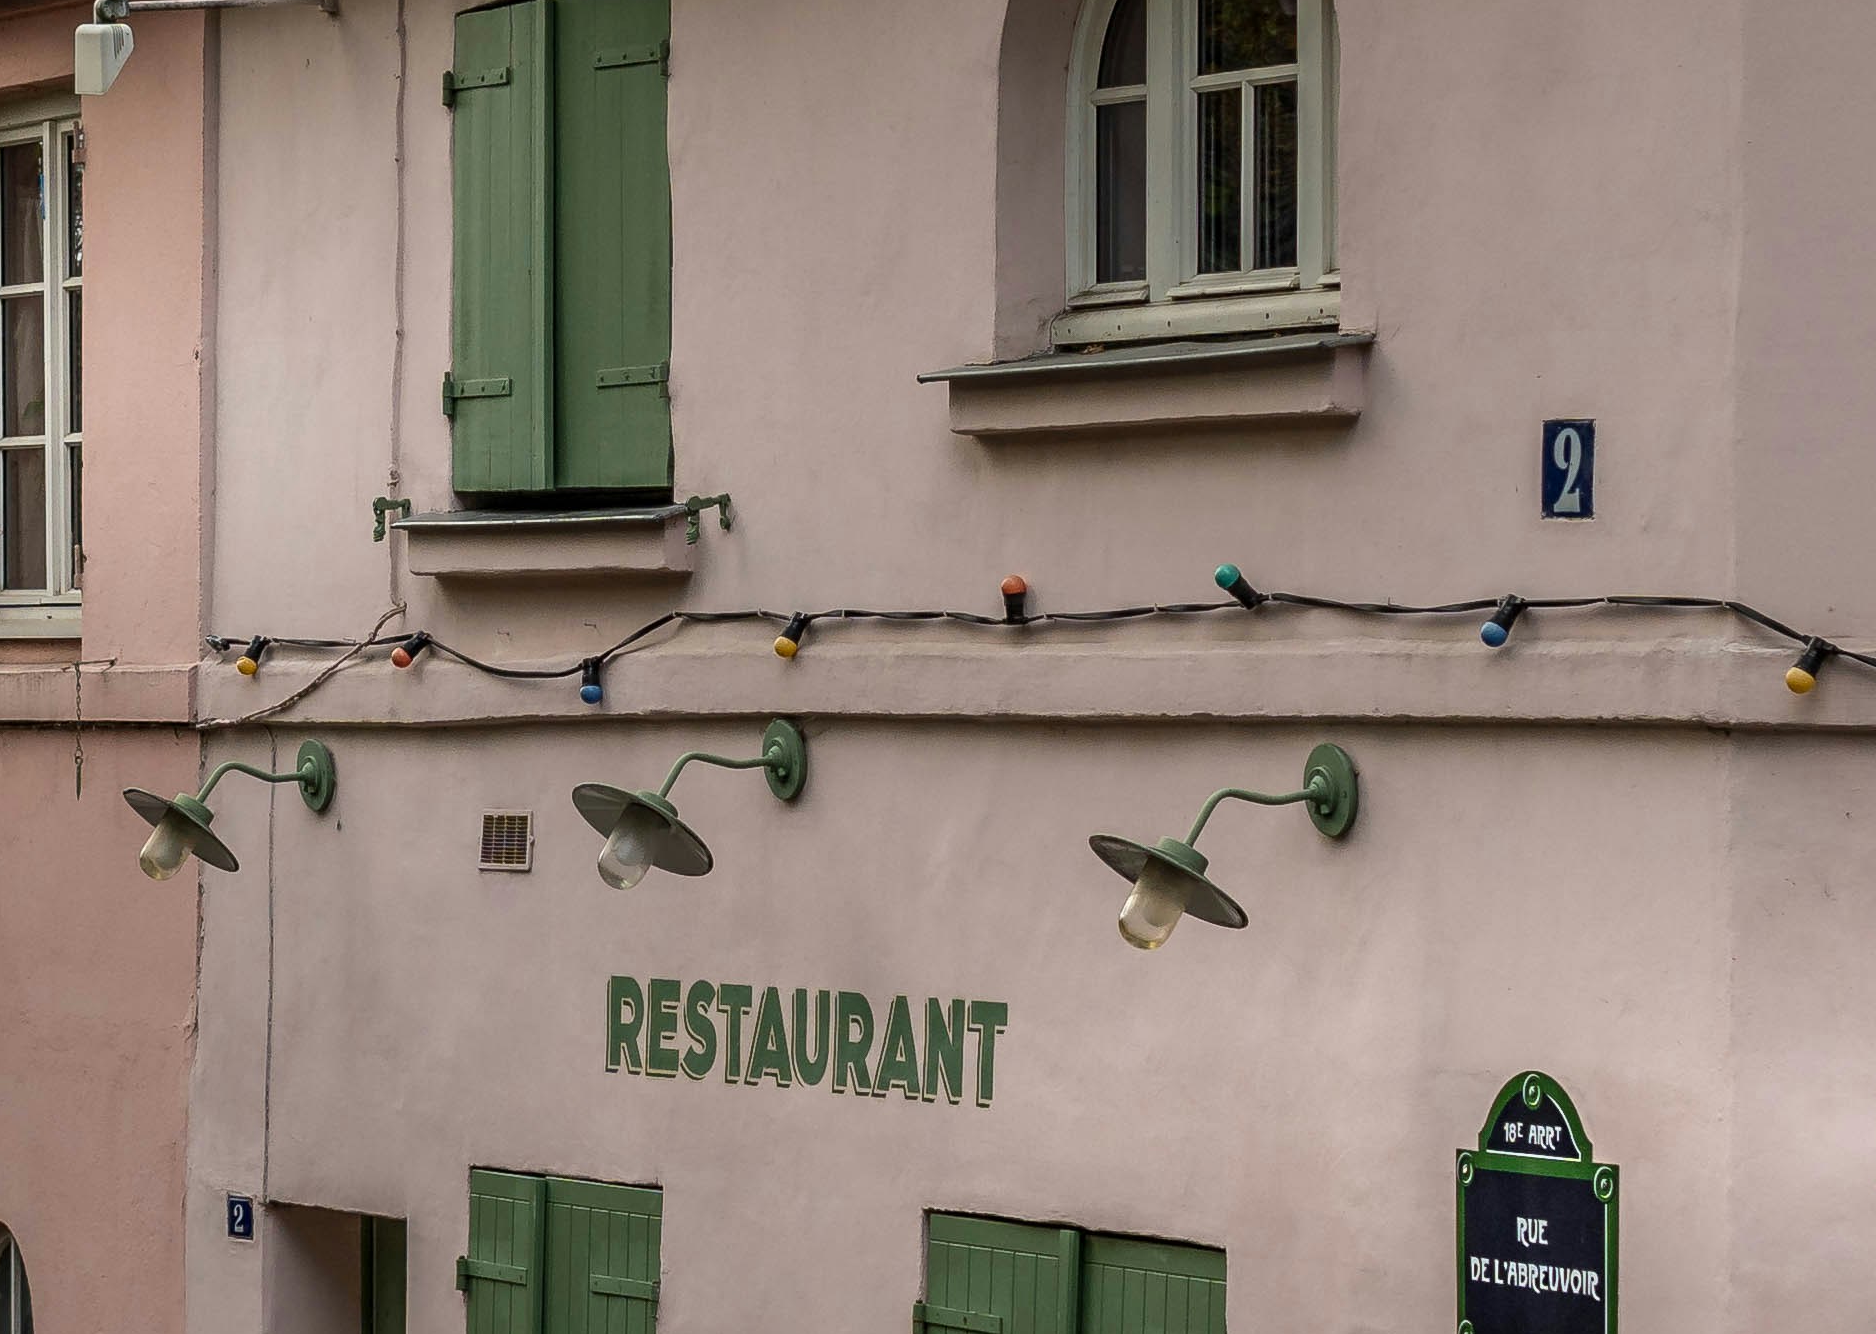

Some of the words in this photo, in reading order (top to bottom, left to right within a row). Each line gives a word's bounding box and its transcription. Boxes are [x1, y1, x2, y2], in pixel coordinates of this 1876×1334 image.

[1553, 427, 1582, 513] 2
[604, 974, 1009, 1109] RESTAURANT
[1503, 1121, 1524, 1143] 18E
[1528, 1124, 1563, 1151] ARRT
[233, 1204, 244, 1233] 2
[1516, 1216, 1548, 1248] RUE
[1470, 1255, 1491, 1283] DE
[1494, 1258, 1601, 1302] L'ABREUVOIR
